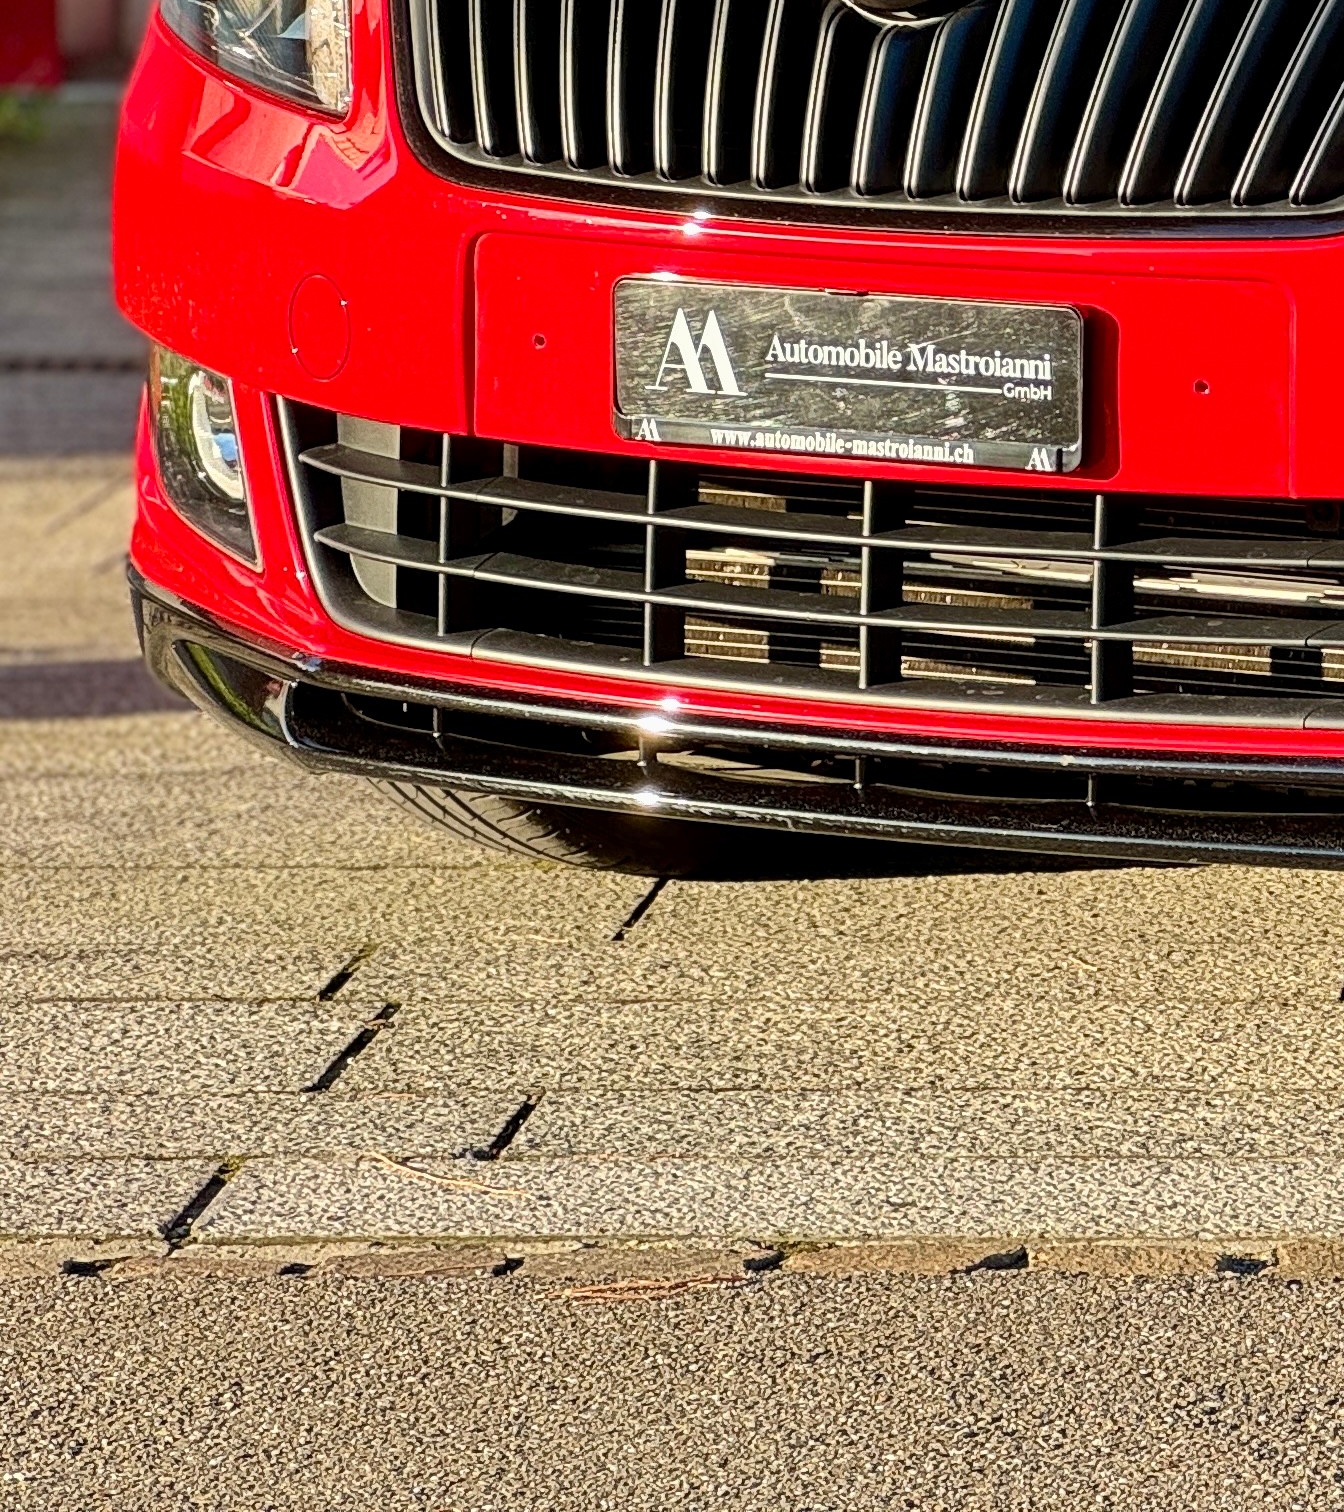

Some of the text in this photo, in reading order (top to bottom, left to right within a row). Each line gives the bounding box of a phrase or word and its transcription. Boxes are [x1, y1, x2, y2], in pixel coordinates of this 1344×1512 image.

[765, 333, 1052, 380] Automobile Mastroianni
[1002, 382, 1053, 401] GmbH
[710, 427, 975, 465] www.automobile-mastroianni.ch
